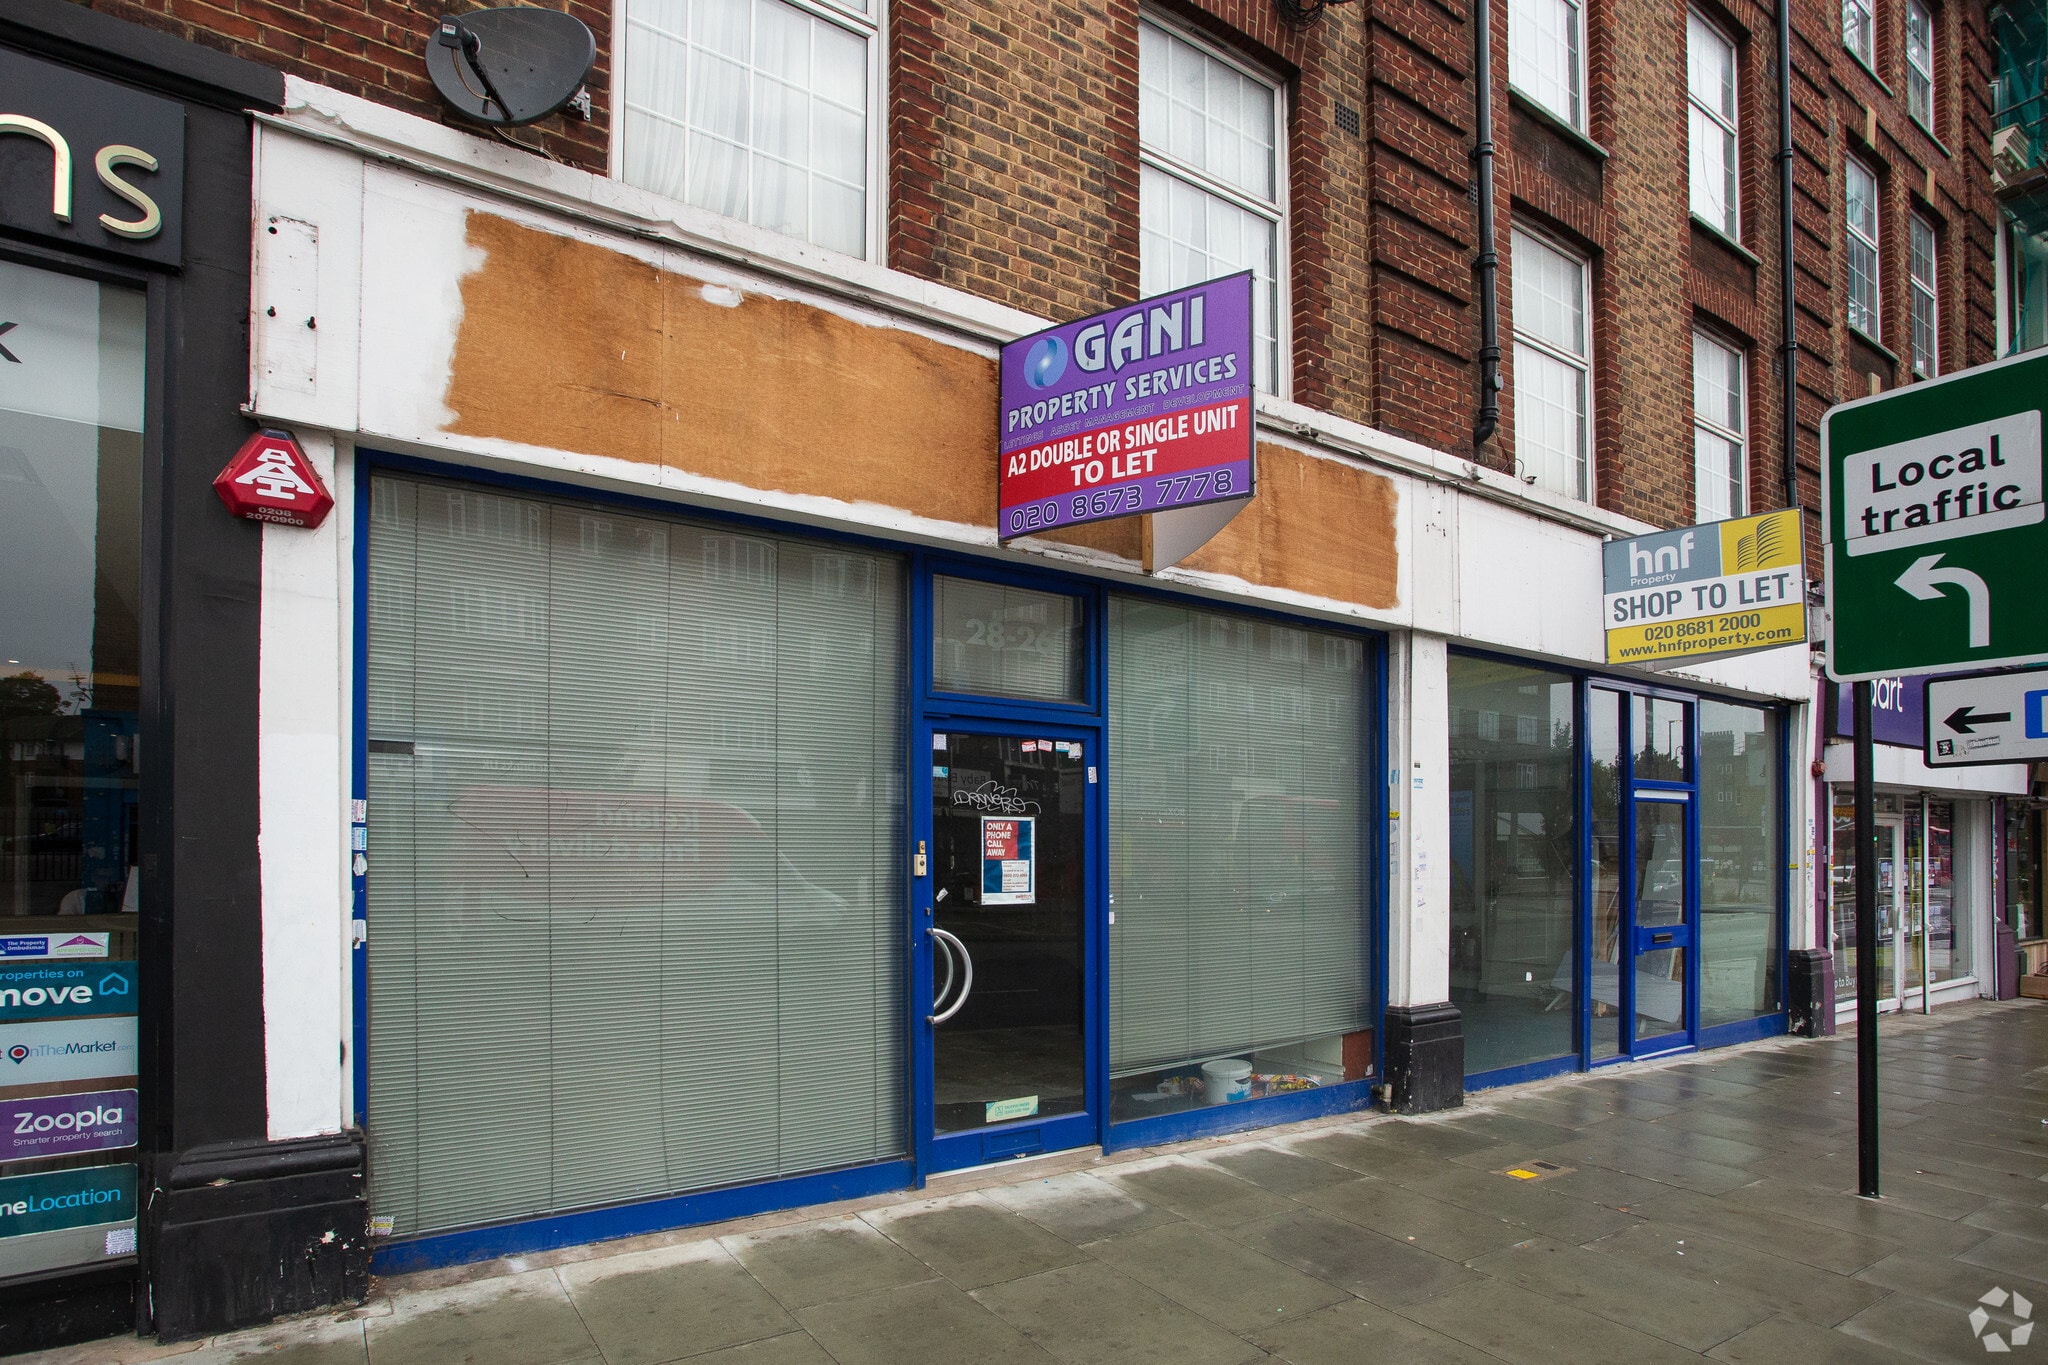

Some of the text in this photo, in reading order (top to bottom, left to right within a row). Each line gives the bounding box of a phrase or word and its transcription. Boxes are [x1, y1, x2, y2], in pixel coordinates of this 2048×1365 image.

[1073, 293, 1205, 373] GANI
[1008, 353, 1237, 433] PROPERTY SERVICES
[1085, 403, 1155, 427] MANAGEMENT
[1163, 384, 1245, 410] DEVELOPMENT
[1007, 405, 1239, 477] A2 DOUBLE OR SINGLE UNIT
[1070, 449, 1157, 486] TO LET
[1872, 434, 2005, 494] Local
[258, 507, 292, 517] 0208
[1010, 469, 1232, 531] 020 8673 7778
[1861, 482, 2022, 536] traffic
[246, 512, 304, 525] 2070900
[1629, 532, 1694, 577] hnf
[1630, 573, 1676, 586] Property
[1613, 573, 1789, 622] SHOP TO LET
[1644, 613, 1761, 641] 020 8681 2000
[1620, 627, 1791, 657] www.hnfproperty.com
[986, 822, 1012, 831] ONLY A
[986, 831, 1011, 839] PHONE
[986, 840, 1003, 848] CALL
[986, 848, 1006, 856] AWAY
[67, 970, 84, 978] on
[14, 1105, 122, 1134] Zoopla
[13, 1128, 122, 1147] Smarter property search
